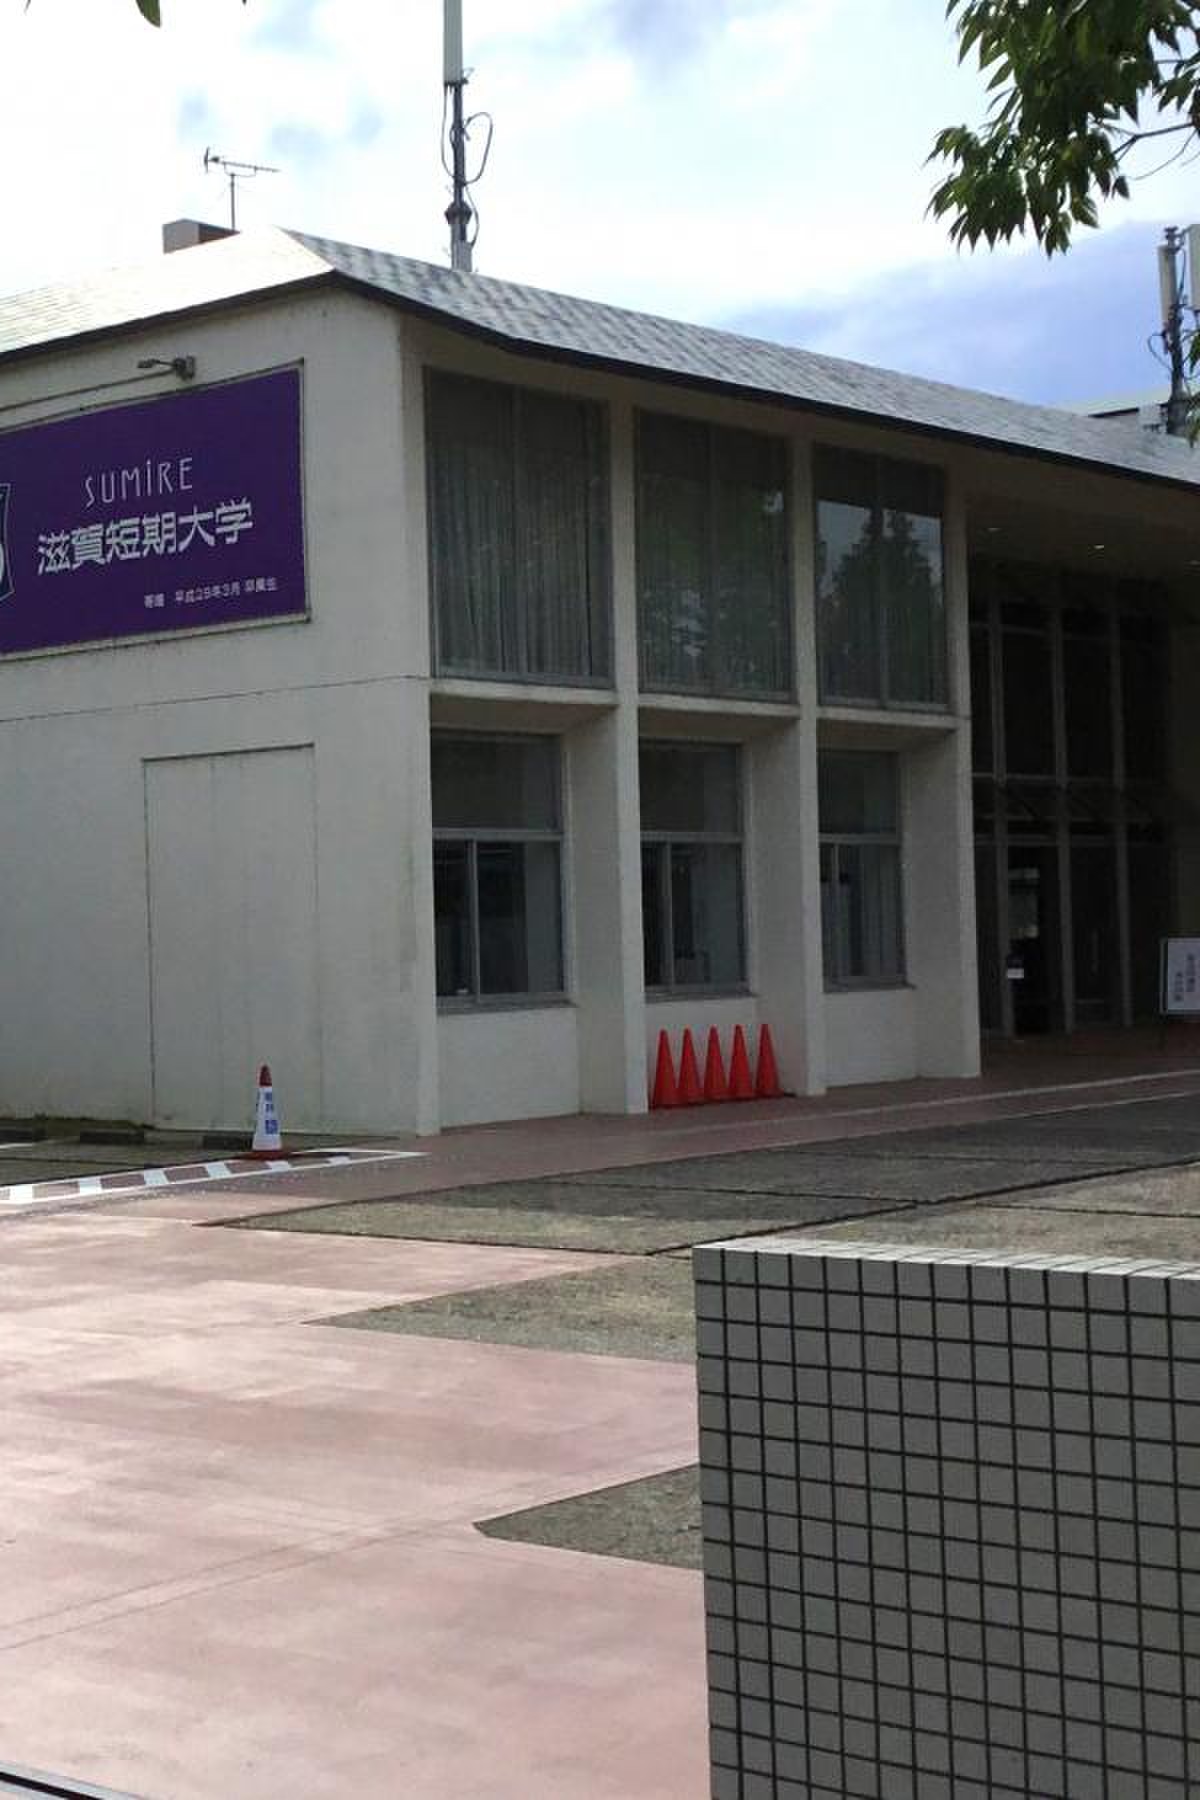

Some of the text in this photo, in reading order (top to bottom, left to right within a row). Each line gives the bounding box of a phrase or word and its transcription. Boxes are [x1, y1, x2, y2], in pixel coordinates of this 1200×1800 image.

[38, 497, 254, 576] 滋賀短期大学
